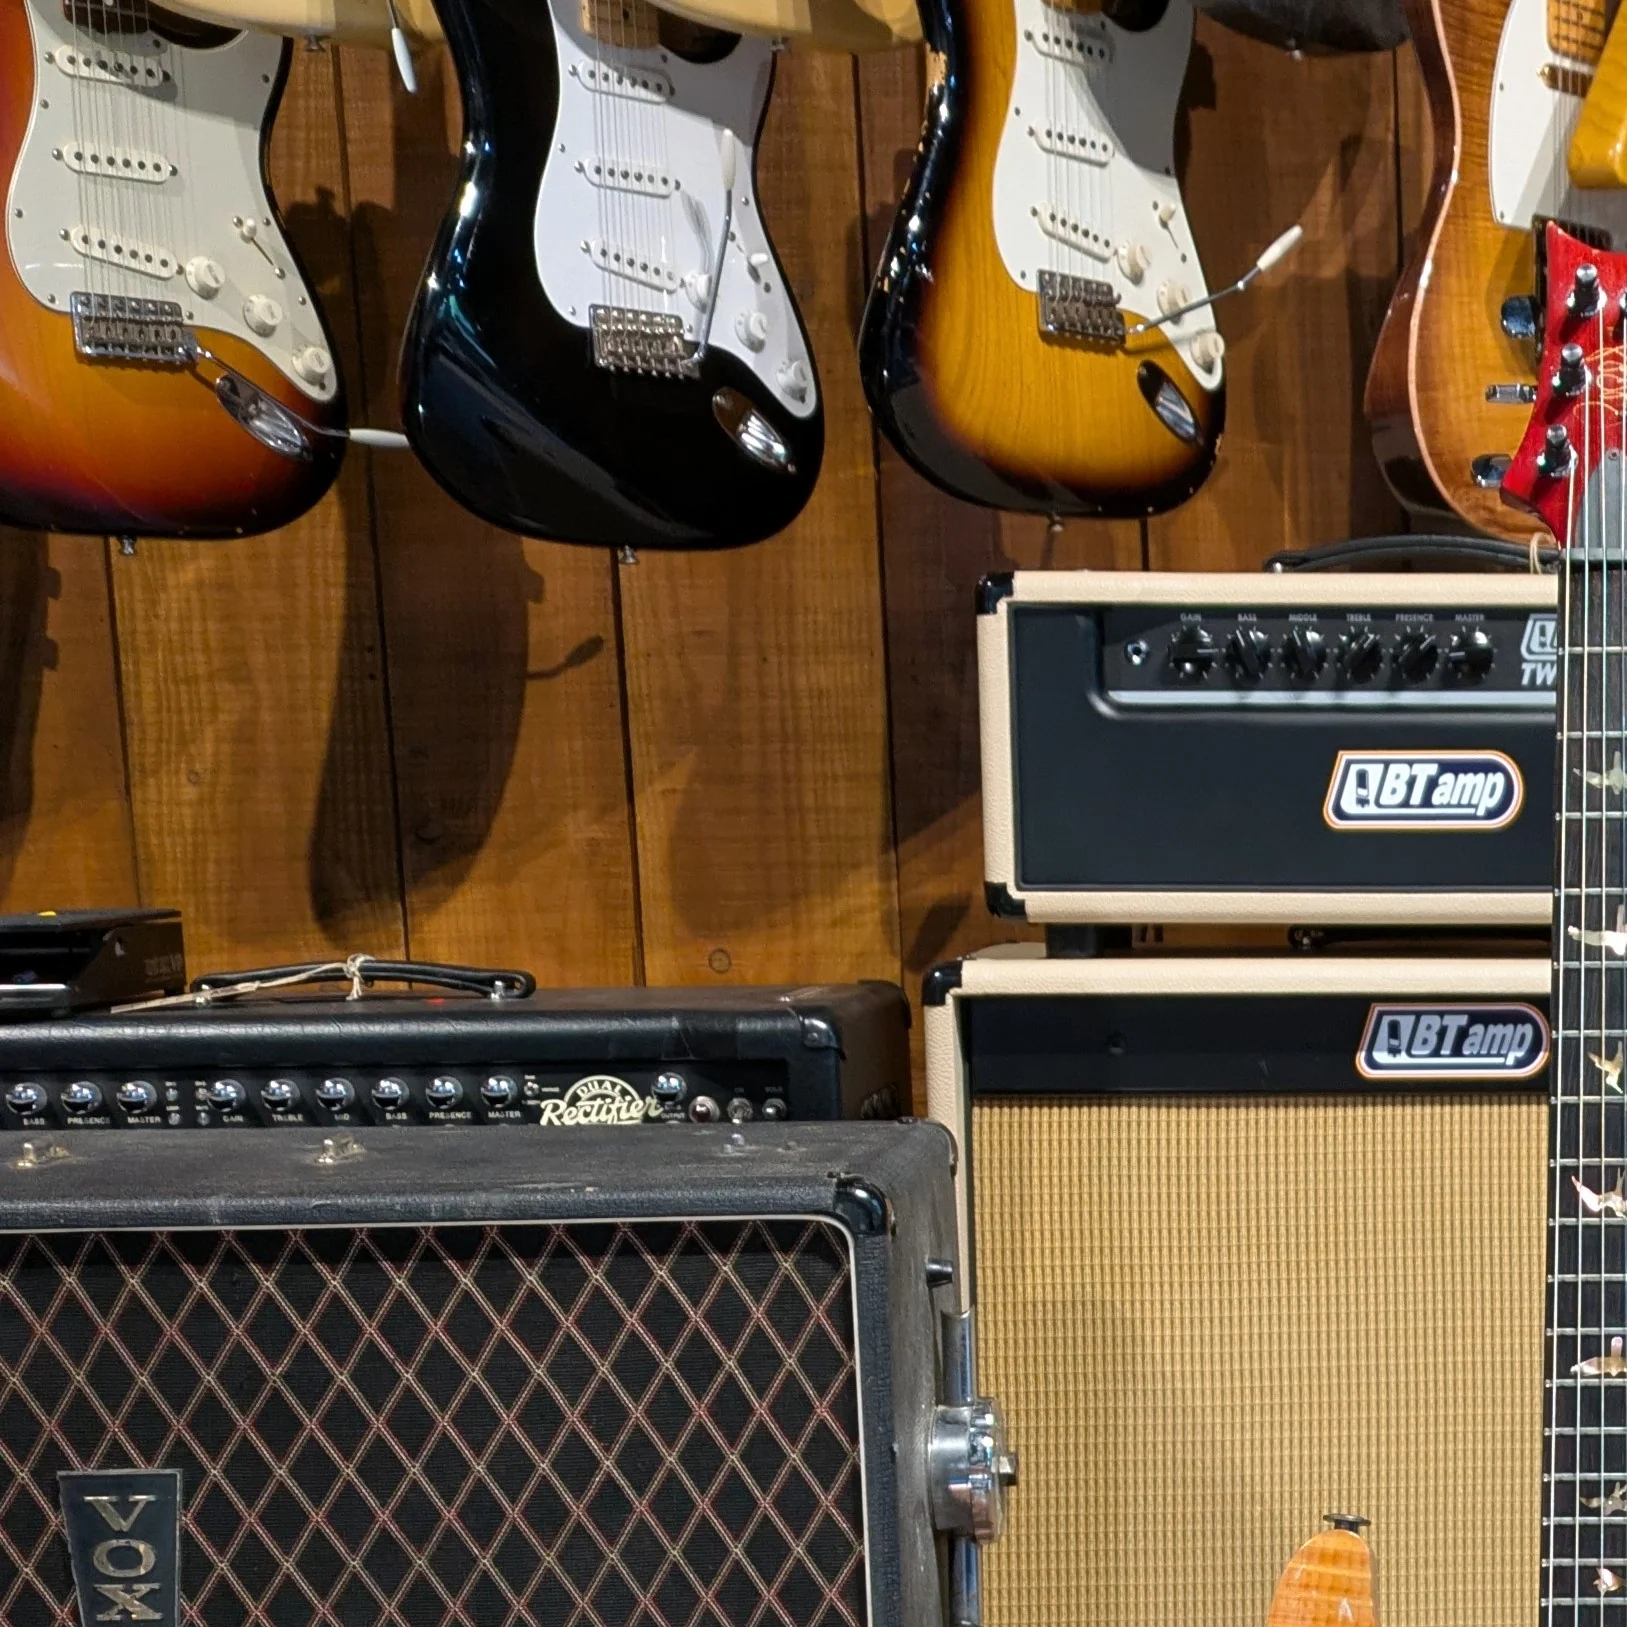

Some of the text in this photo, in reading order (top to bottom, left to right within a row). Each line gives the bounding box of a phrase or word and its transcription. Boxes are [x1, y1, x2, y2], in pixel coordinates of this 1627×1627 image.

[1180, 613, 1202, 622] GAIN
[1237, 613, 1257, 622] BASS
[1288, 613, 1317, 622] MIDDLE
[1346, 612, 1371, 622] TREBLE
[1395, 612, 1433, 622] PRESENCE
[1454, 612, 1485, 622] MASTER
[1520, 662, 1557, 686] TW
[575, 1079, 625, 1099] DUAL
[488, 1110, 521, 1118] MASTER
[540, 1094, 663, 1125] Rectifier
[127, 1116, 161, 1124] MASTER
[223, 1115, 244, 1123] GAIN
[272, 1113, 304, 1122] TREBLE
[385, 1112, 407, 1120] BASS
[429, 1111, 472, 1120] PRESENCE
[23, 1117, 46, 1126] BASS
[67, 1116, 110, 1125] PRESENCE
[83, 1495, 163, 1621] VOX
